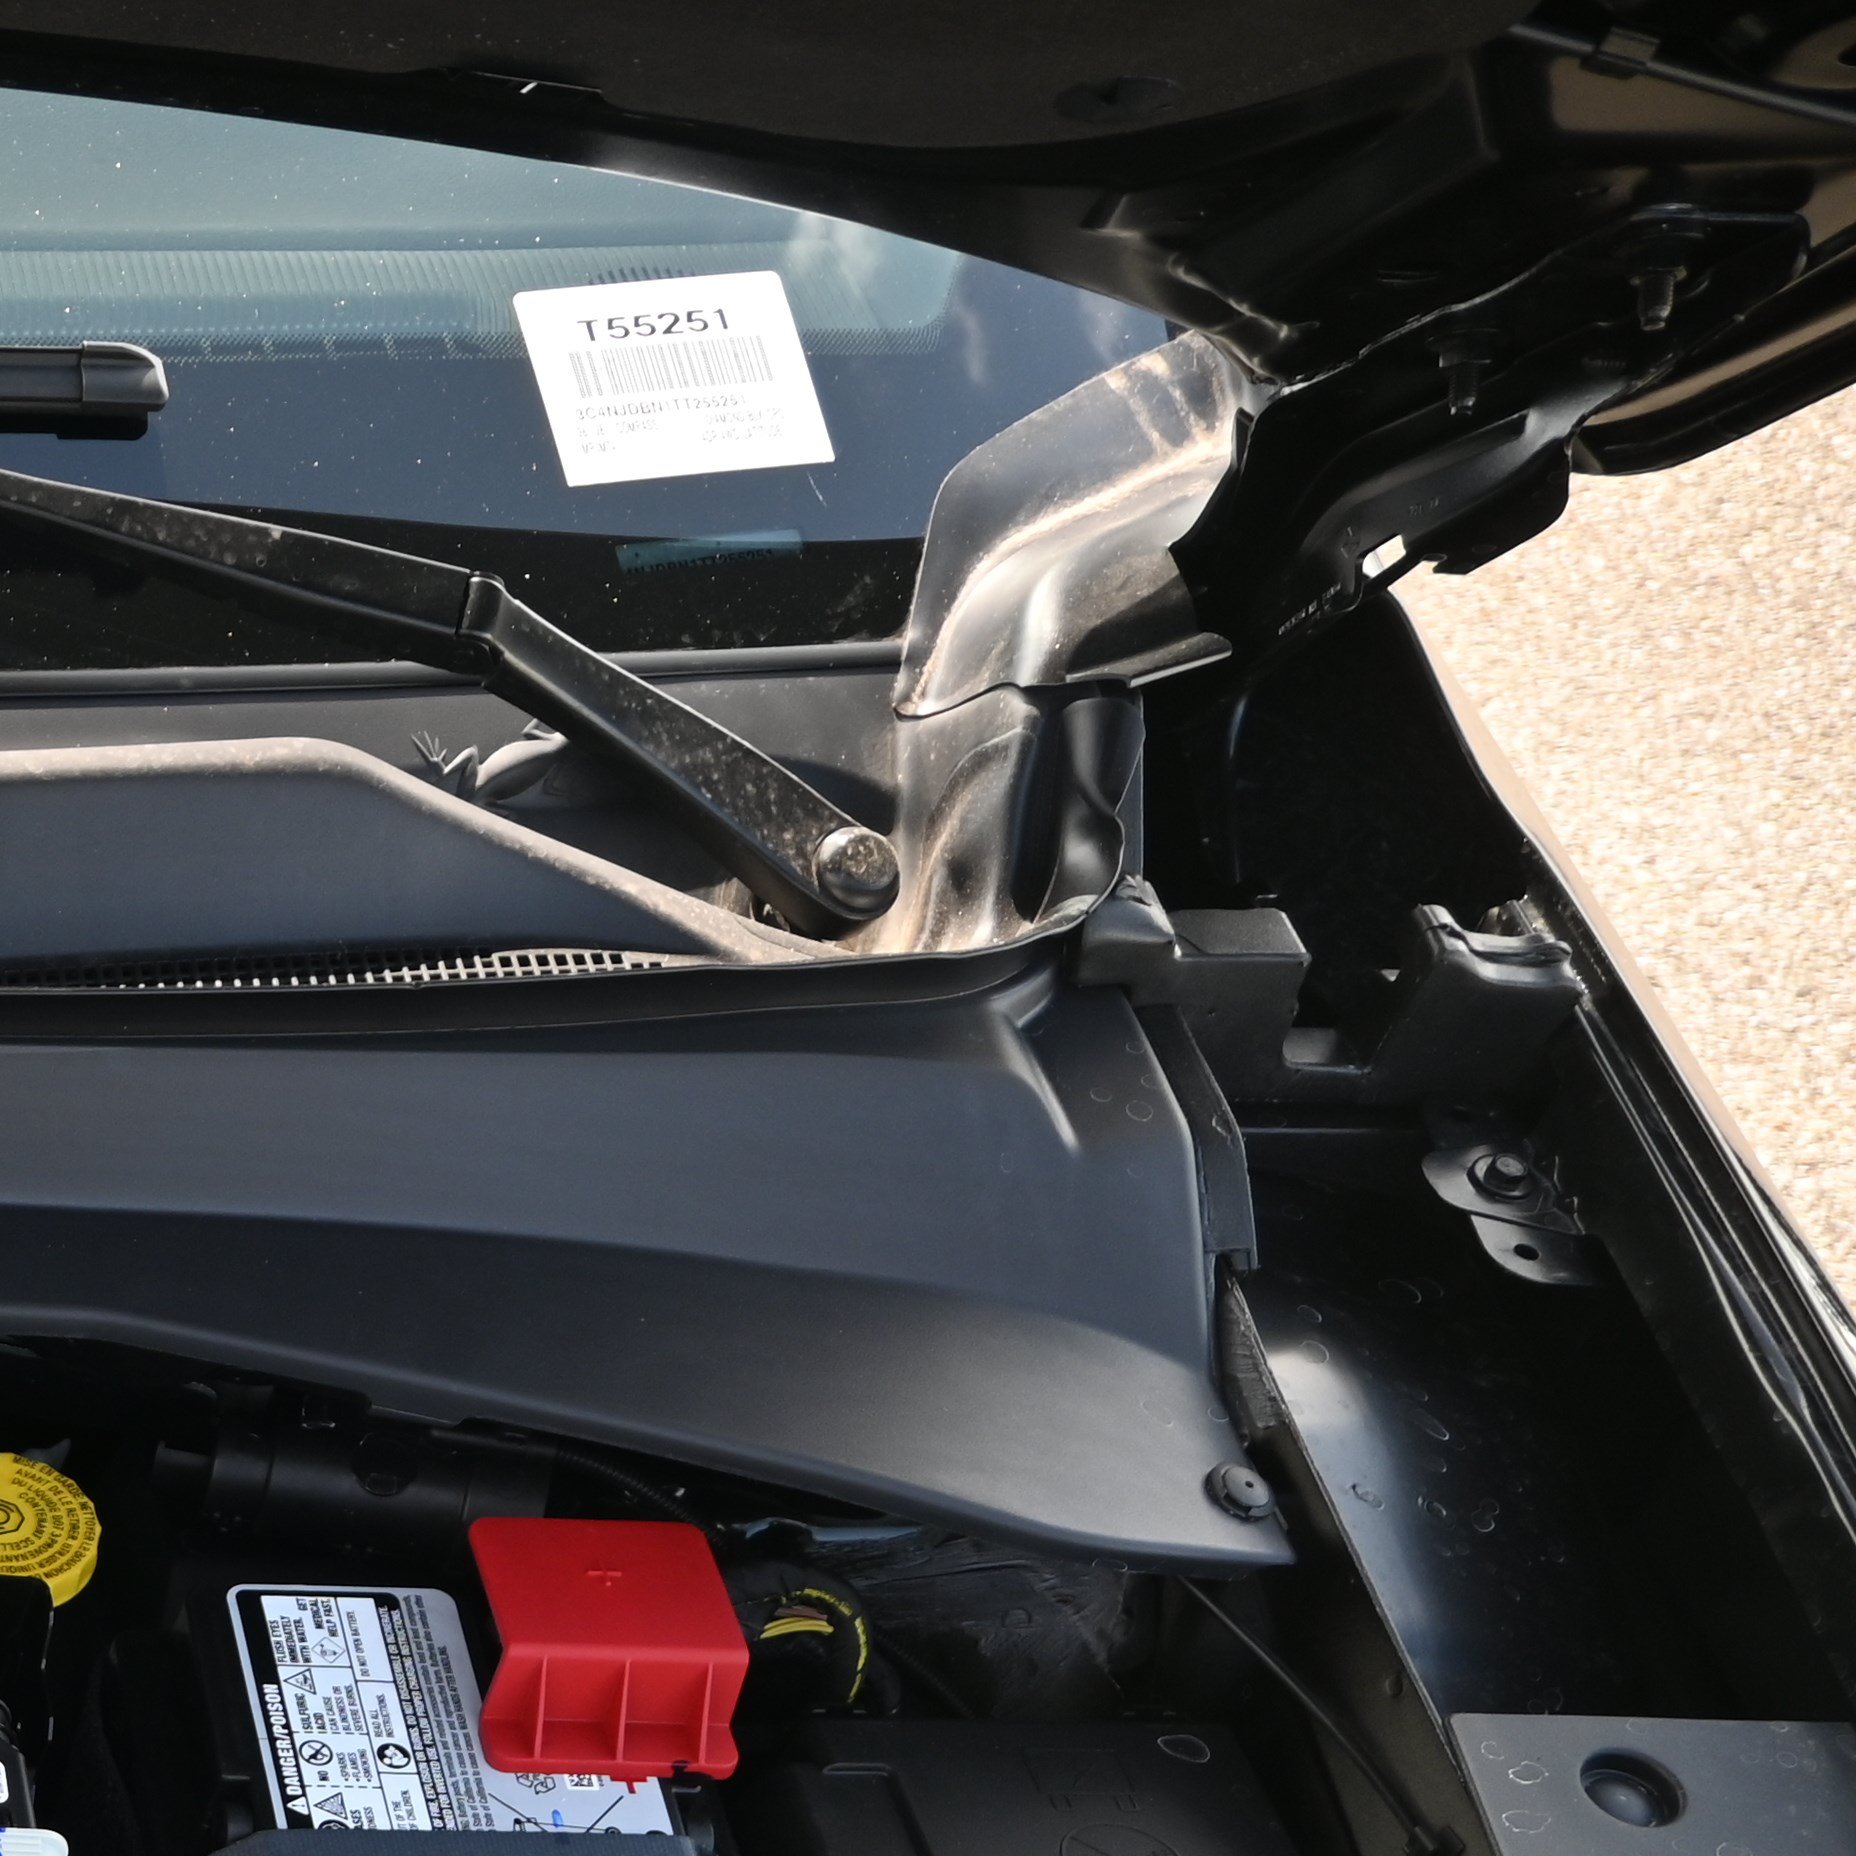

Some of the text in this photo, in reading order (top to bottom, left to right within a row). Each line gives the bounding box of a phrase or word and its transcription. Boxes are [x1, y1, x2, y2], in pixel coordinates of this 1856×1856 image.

[577, 308, 729, 342] T55251
[295, 1597, 308, 1610] GET
[268, 1619, 281, 1637] EYES
[325, 1619, 338, 1637] HELP
[351, 1638, 364, 1653] OPEN
[355, 1655, 367, 1666] NOT
[358, 1668, 370, 1676] DO
[294, 1693, 313, 1729] SULFURIC
[322, 1696, 339, 1730] CAN CAUSE
[334, 1696, 351, 1730] BLINDNESS
[349, 1707, 363, 1731] SEVERE
[312, 1712, 326, 1730] ACID
[368, 1708, 383, 1737] READ ALL
[263, 1684, 302, 1795] DANGER/POISON
[316, 1770, 330, 1781] NO
